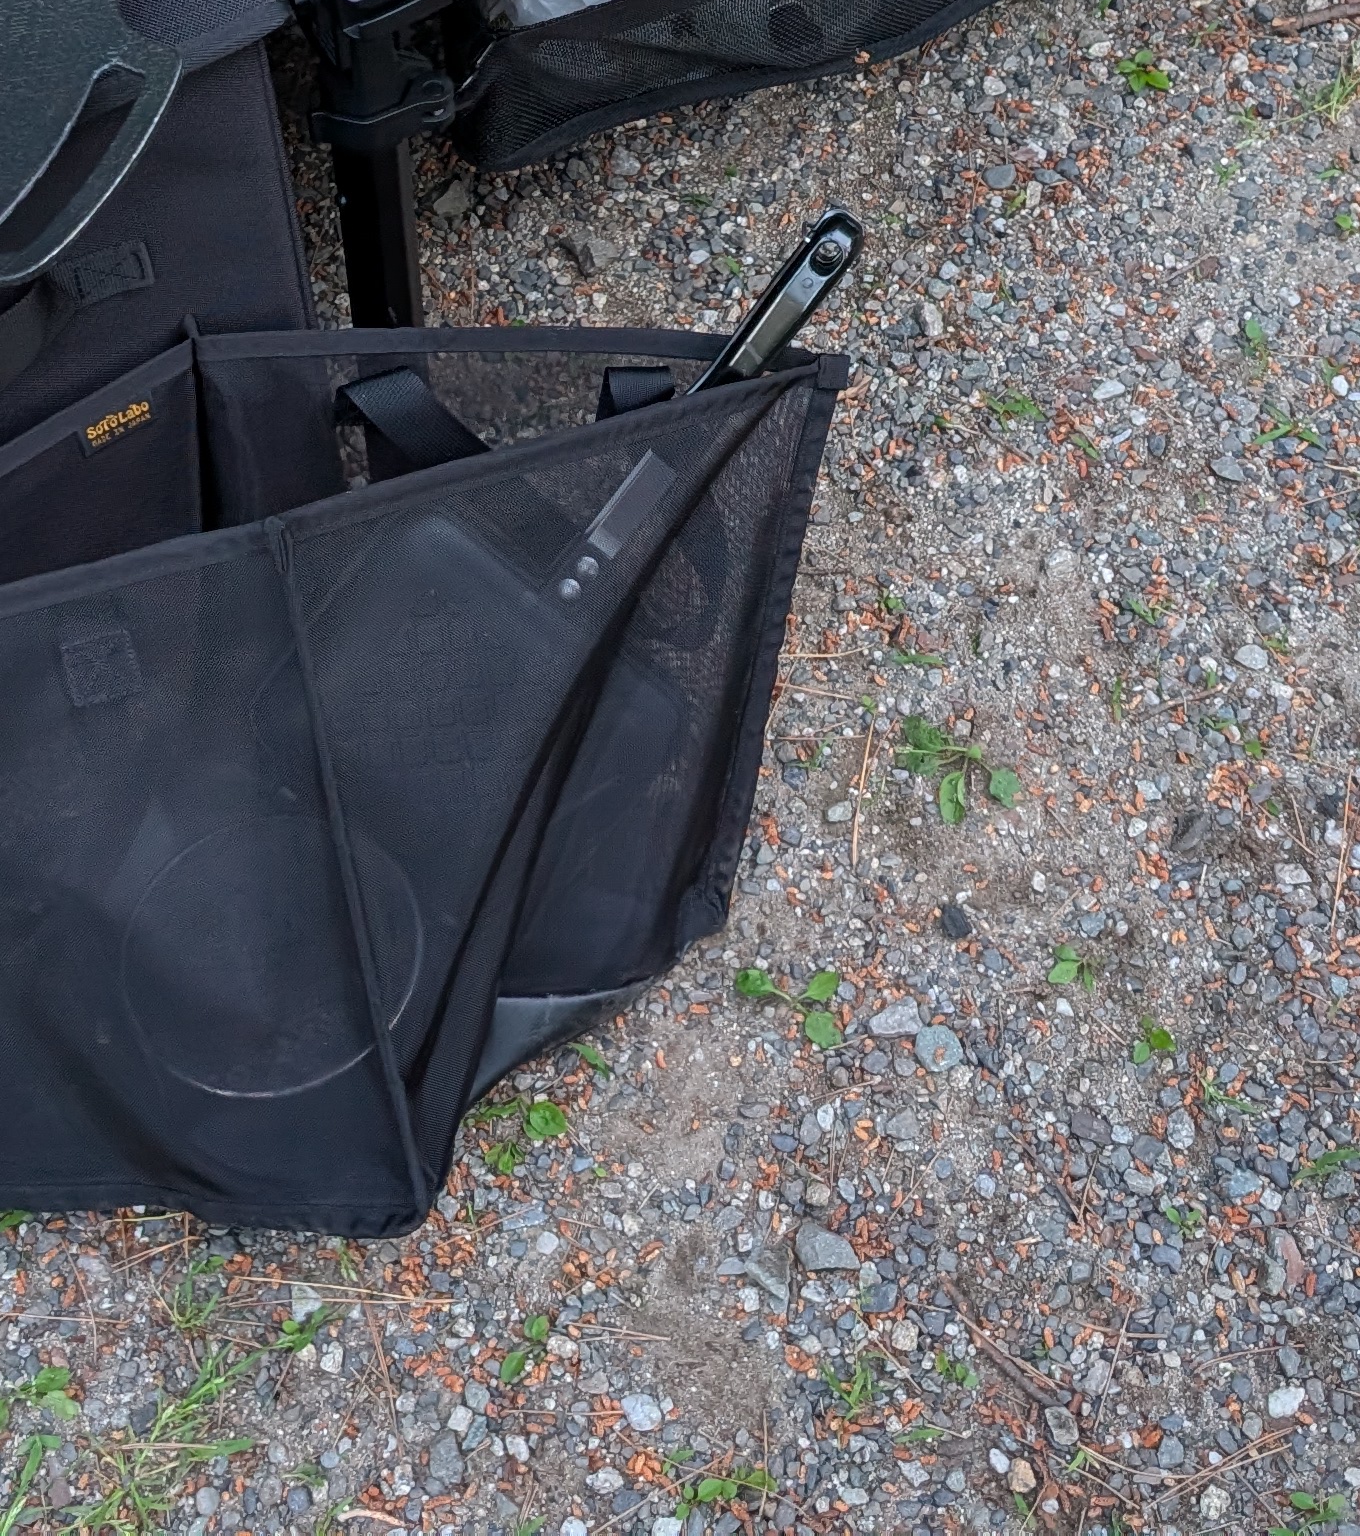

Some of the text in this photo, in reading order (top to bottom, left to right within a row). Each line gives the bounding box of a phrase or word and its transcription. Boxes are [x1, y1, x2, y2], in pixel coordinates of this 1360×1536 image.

[92, 412, 151, 447] MADE IN JAPAN
